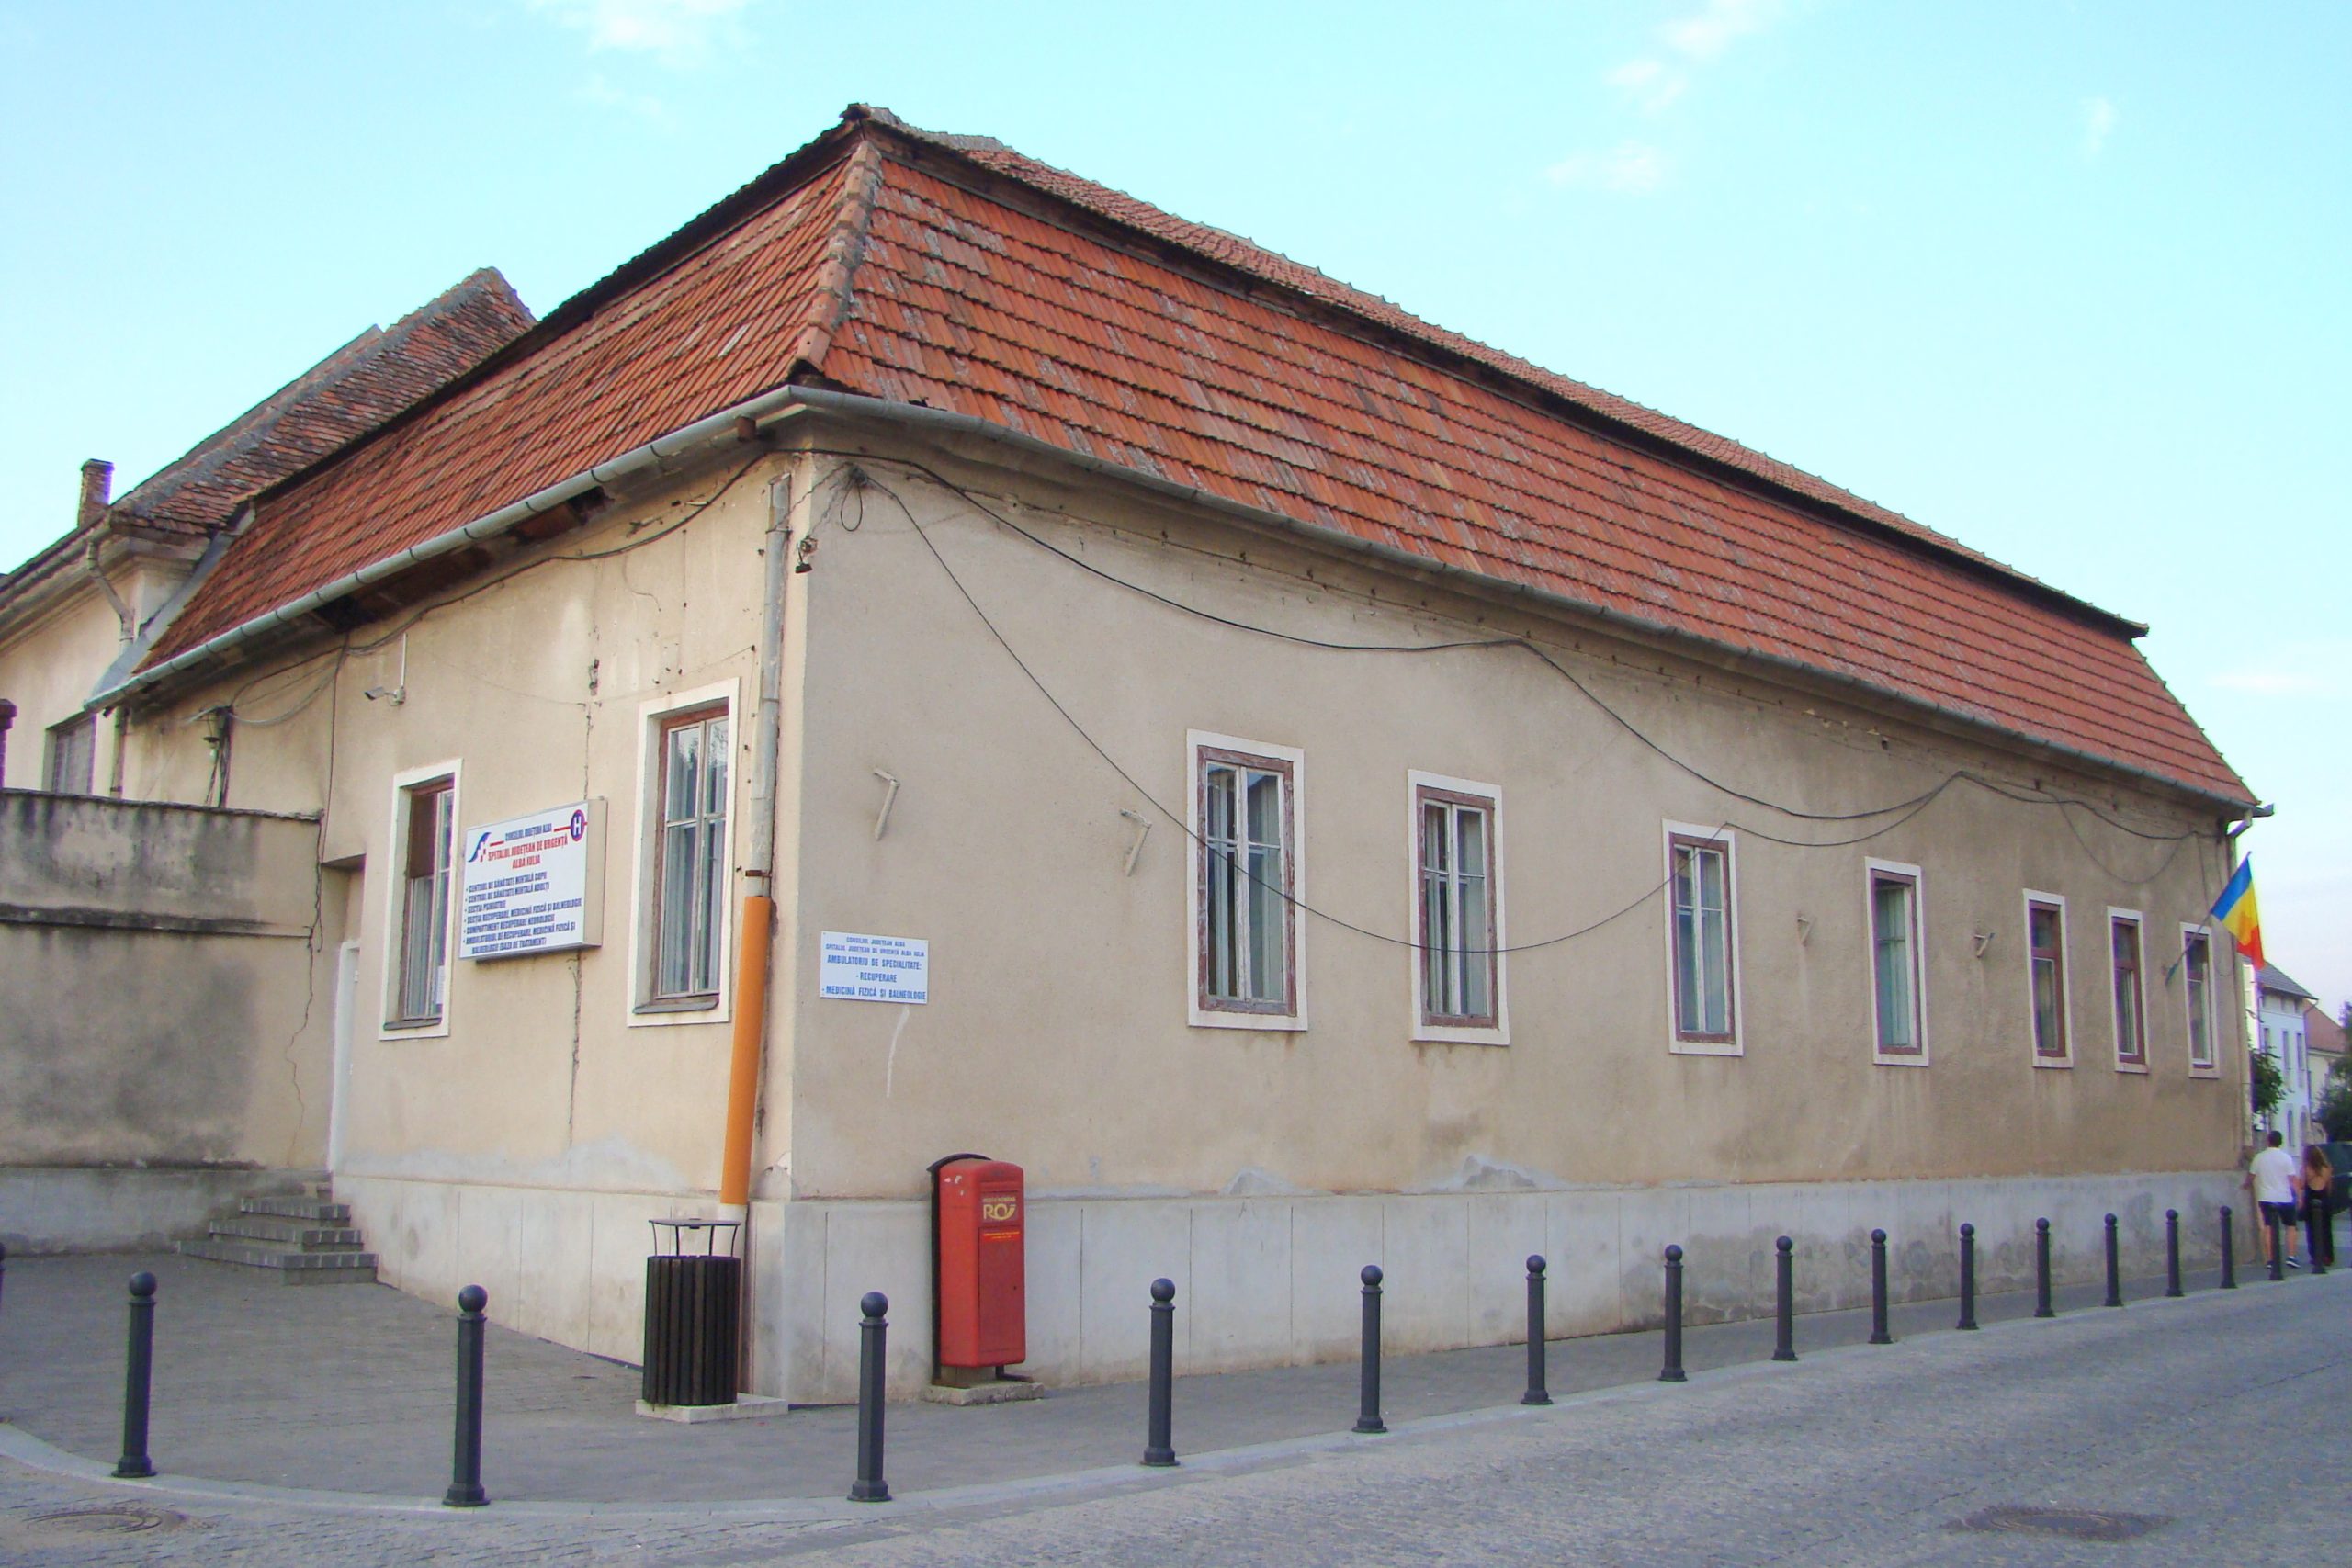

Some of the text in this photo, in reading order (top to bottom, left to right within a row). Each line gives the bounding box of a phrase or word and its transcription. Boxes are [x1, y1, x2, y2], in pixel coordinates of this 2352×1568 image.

[573, 816, 582, 837] H
[537, 840, 543, 852] DE
[513, 858, 526, 869] ALBA
[827, 954, 868, 966] AMBULATORIU
[871, 958, 879, 967] DE
[860, 972, 898, 983] RECUPERARE
[888, 989, 926, 1000] BALNEOLOGIE
